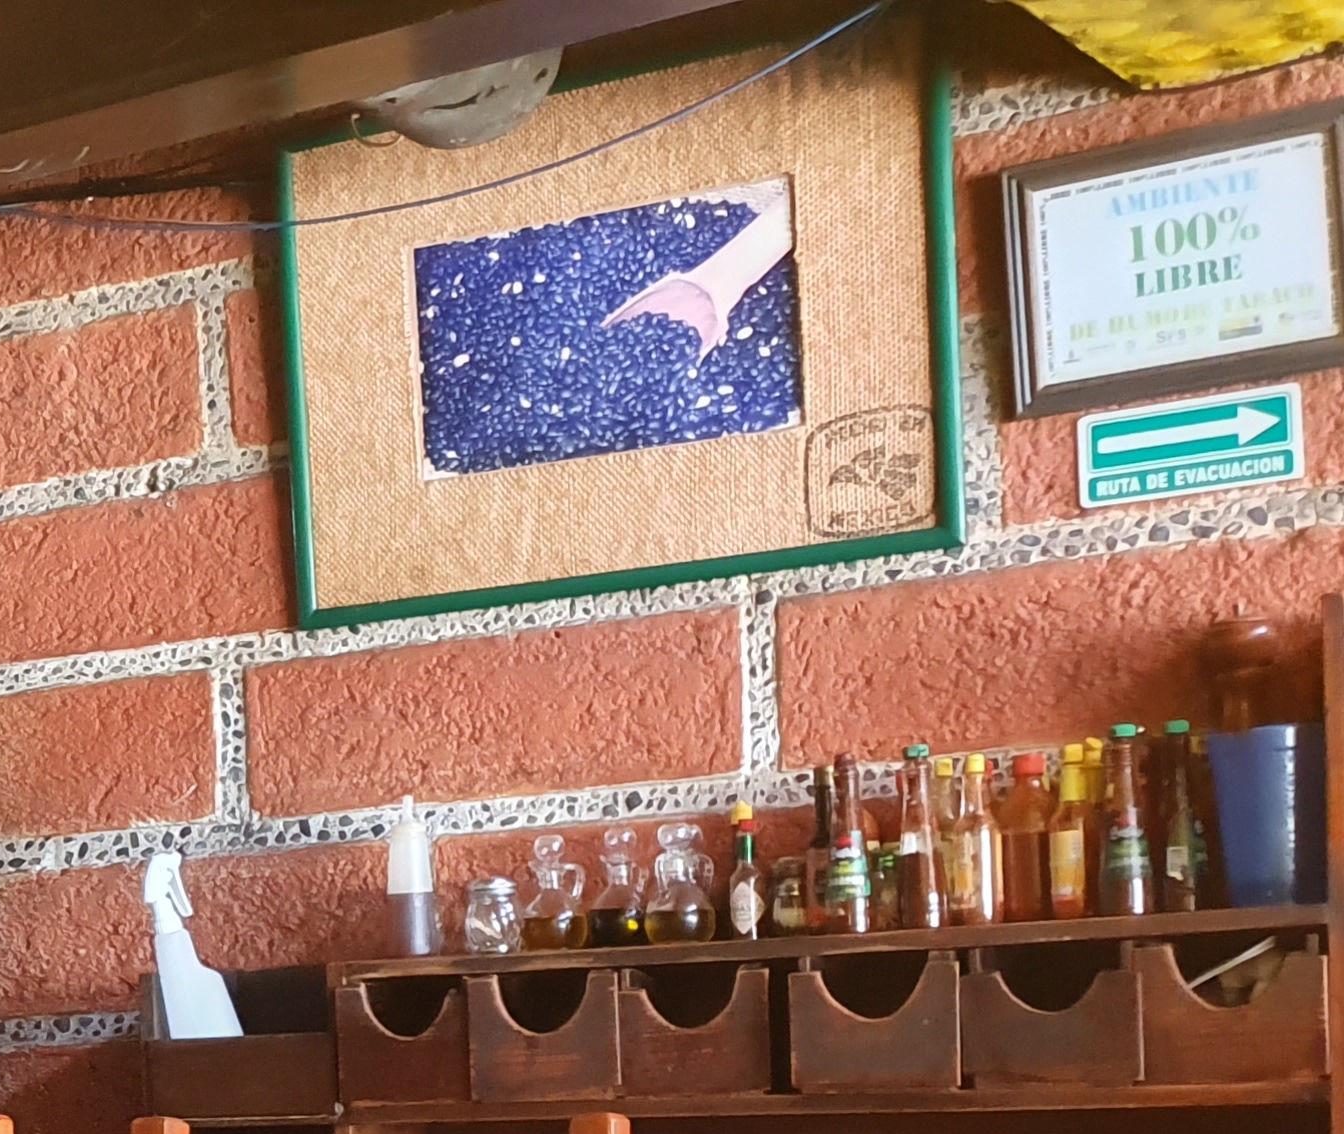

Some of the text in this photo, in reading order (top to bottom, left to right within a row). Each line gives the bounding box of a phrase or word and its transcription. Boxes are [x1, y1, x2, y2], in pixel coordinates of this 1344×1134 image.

[1107, 168, 1259, 218] AMBIENTE
[1129, 204, 1261, 263] 100%
[1135, 254, 1243, 298] LIBRE
[1095, 454, 1287, 498] RUTA DE EVACUACION
